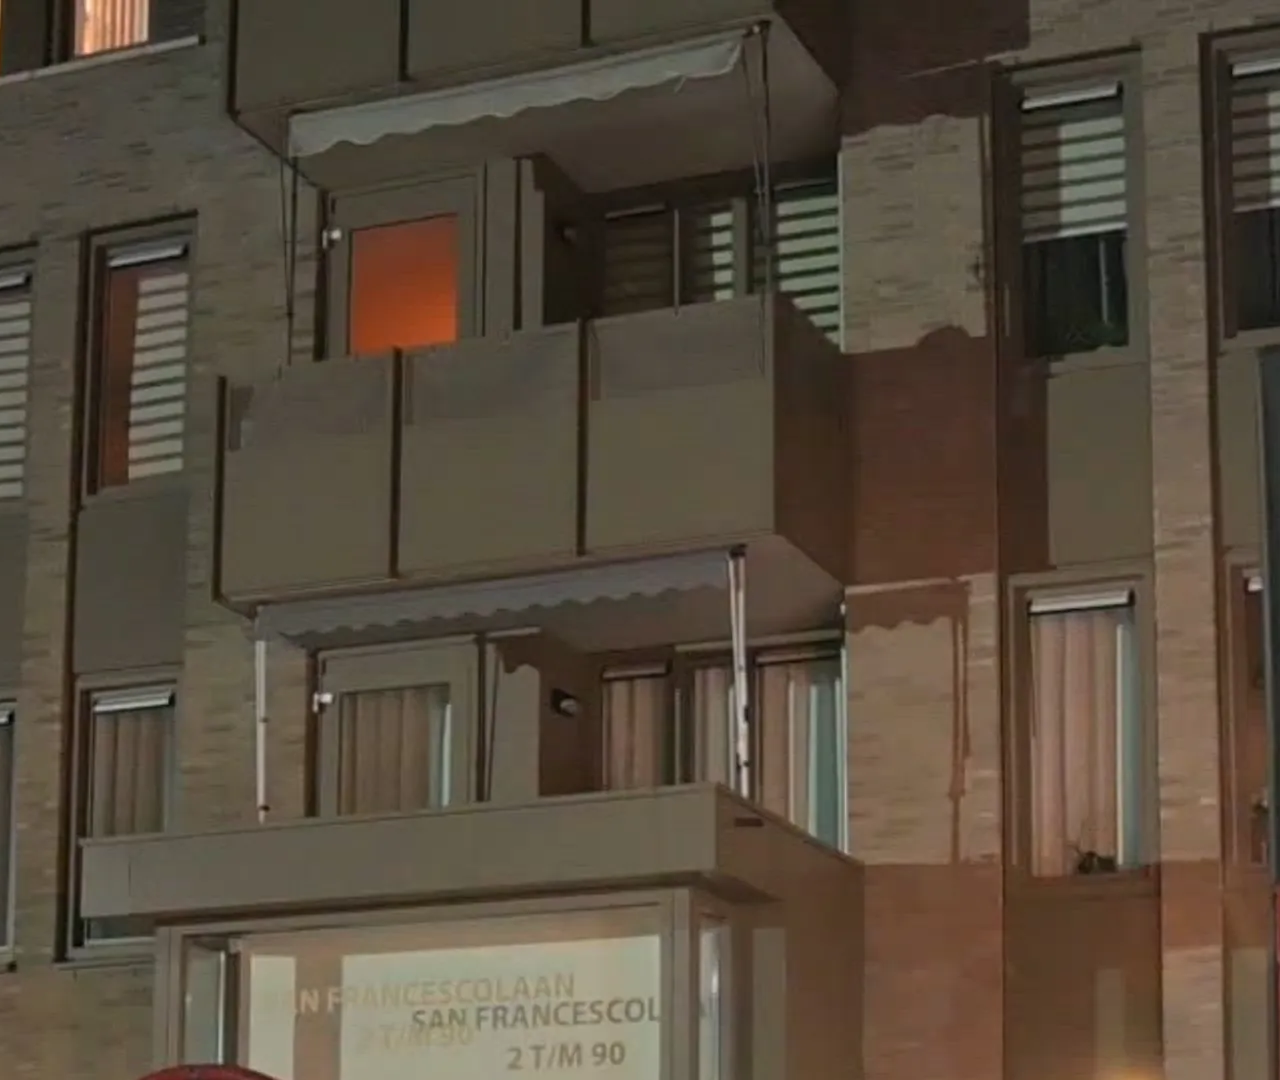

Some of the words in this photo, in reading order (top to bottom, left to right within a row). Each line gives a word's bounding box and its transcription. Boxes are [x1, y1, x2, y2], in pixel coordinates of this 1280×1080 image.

[411, 1007, 468, 1031] SAN
[475, 997, 661, 1031] FRANCESCOL
[506, 1046, 524, 1071] 2
[529, 1042, 583, 1070] T/M
[591, 1040, 626, 1067] 90
